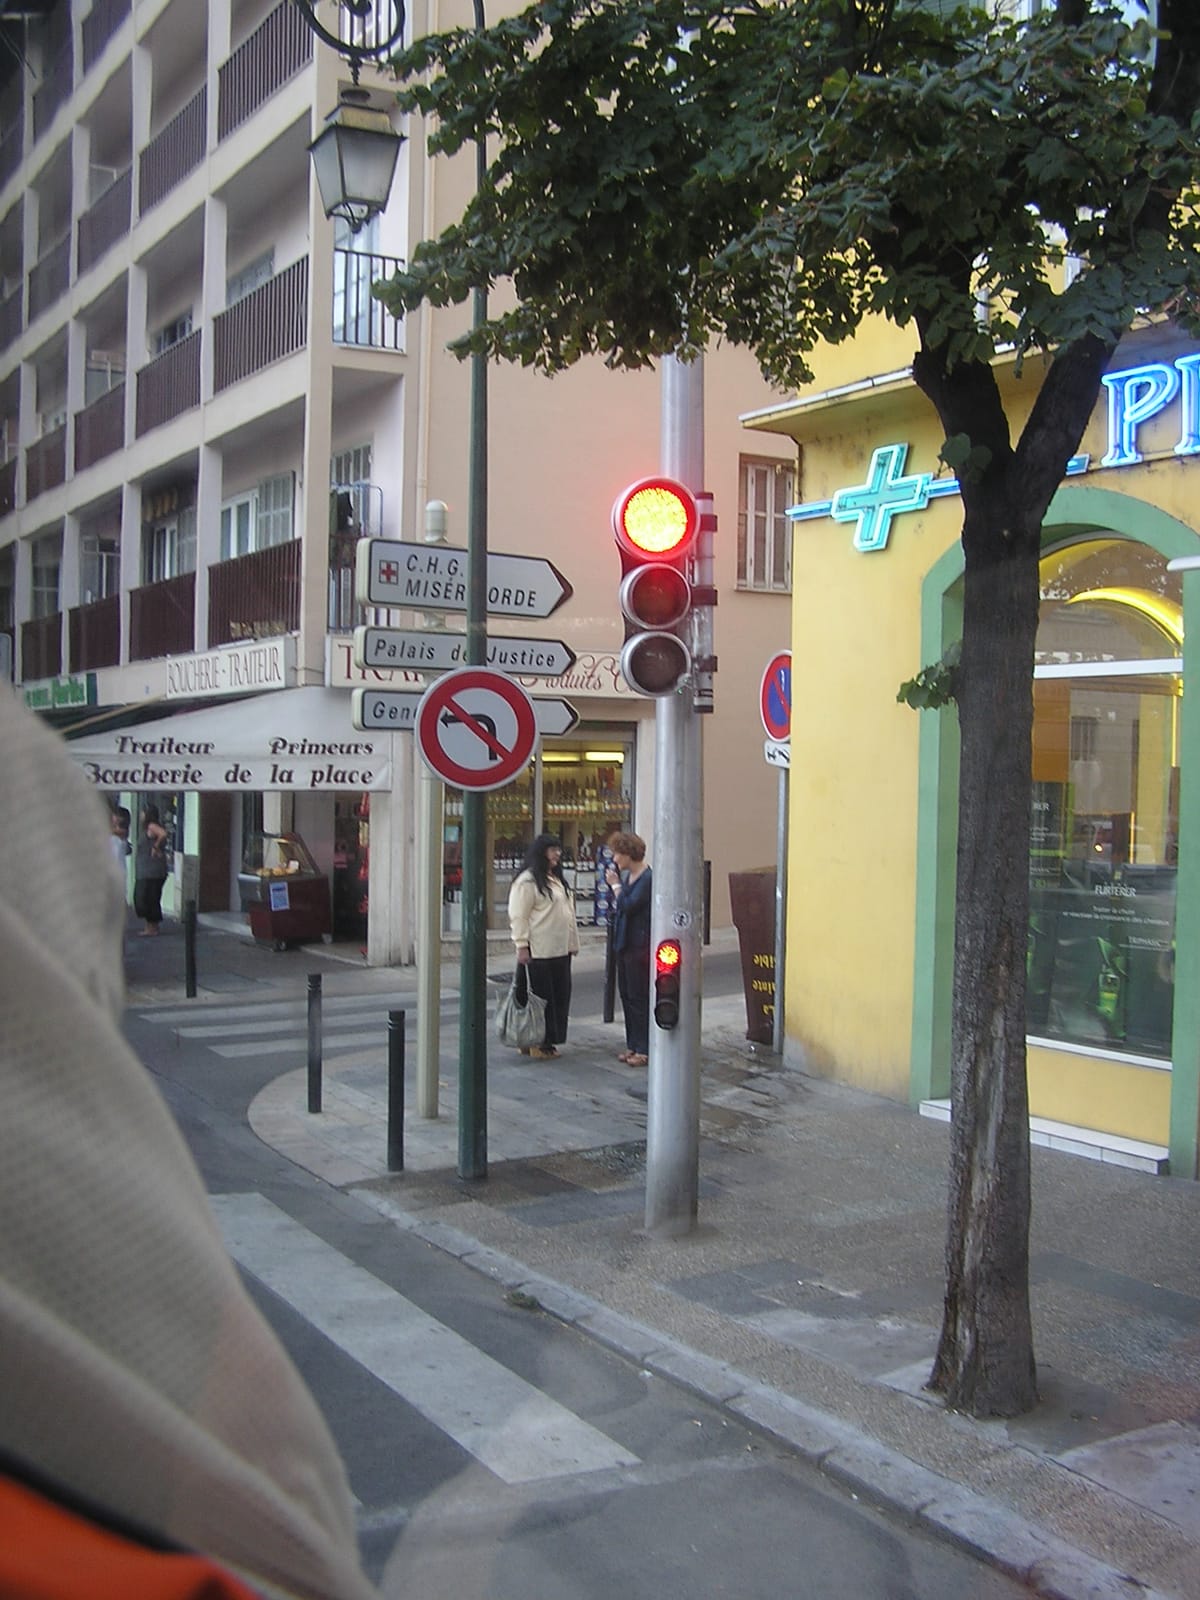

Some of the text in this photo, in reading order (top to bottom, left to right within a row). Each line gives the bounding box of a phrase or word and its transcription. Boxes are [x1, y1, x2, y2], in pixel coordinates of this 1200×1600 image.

[406, 553, 464, 577] C.H.G.
[374, 638, 435, 660] Palais
[486, 645, 555, 668] Justice
[227, 647, 281, 687] TRAITEUR
[115, 735, 374, 755] Traiteur Primeurs
[224, 763, 251, 784] de
[270, 764, 294, 784] la
[310, 764, 374, 787] place
